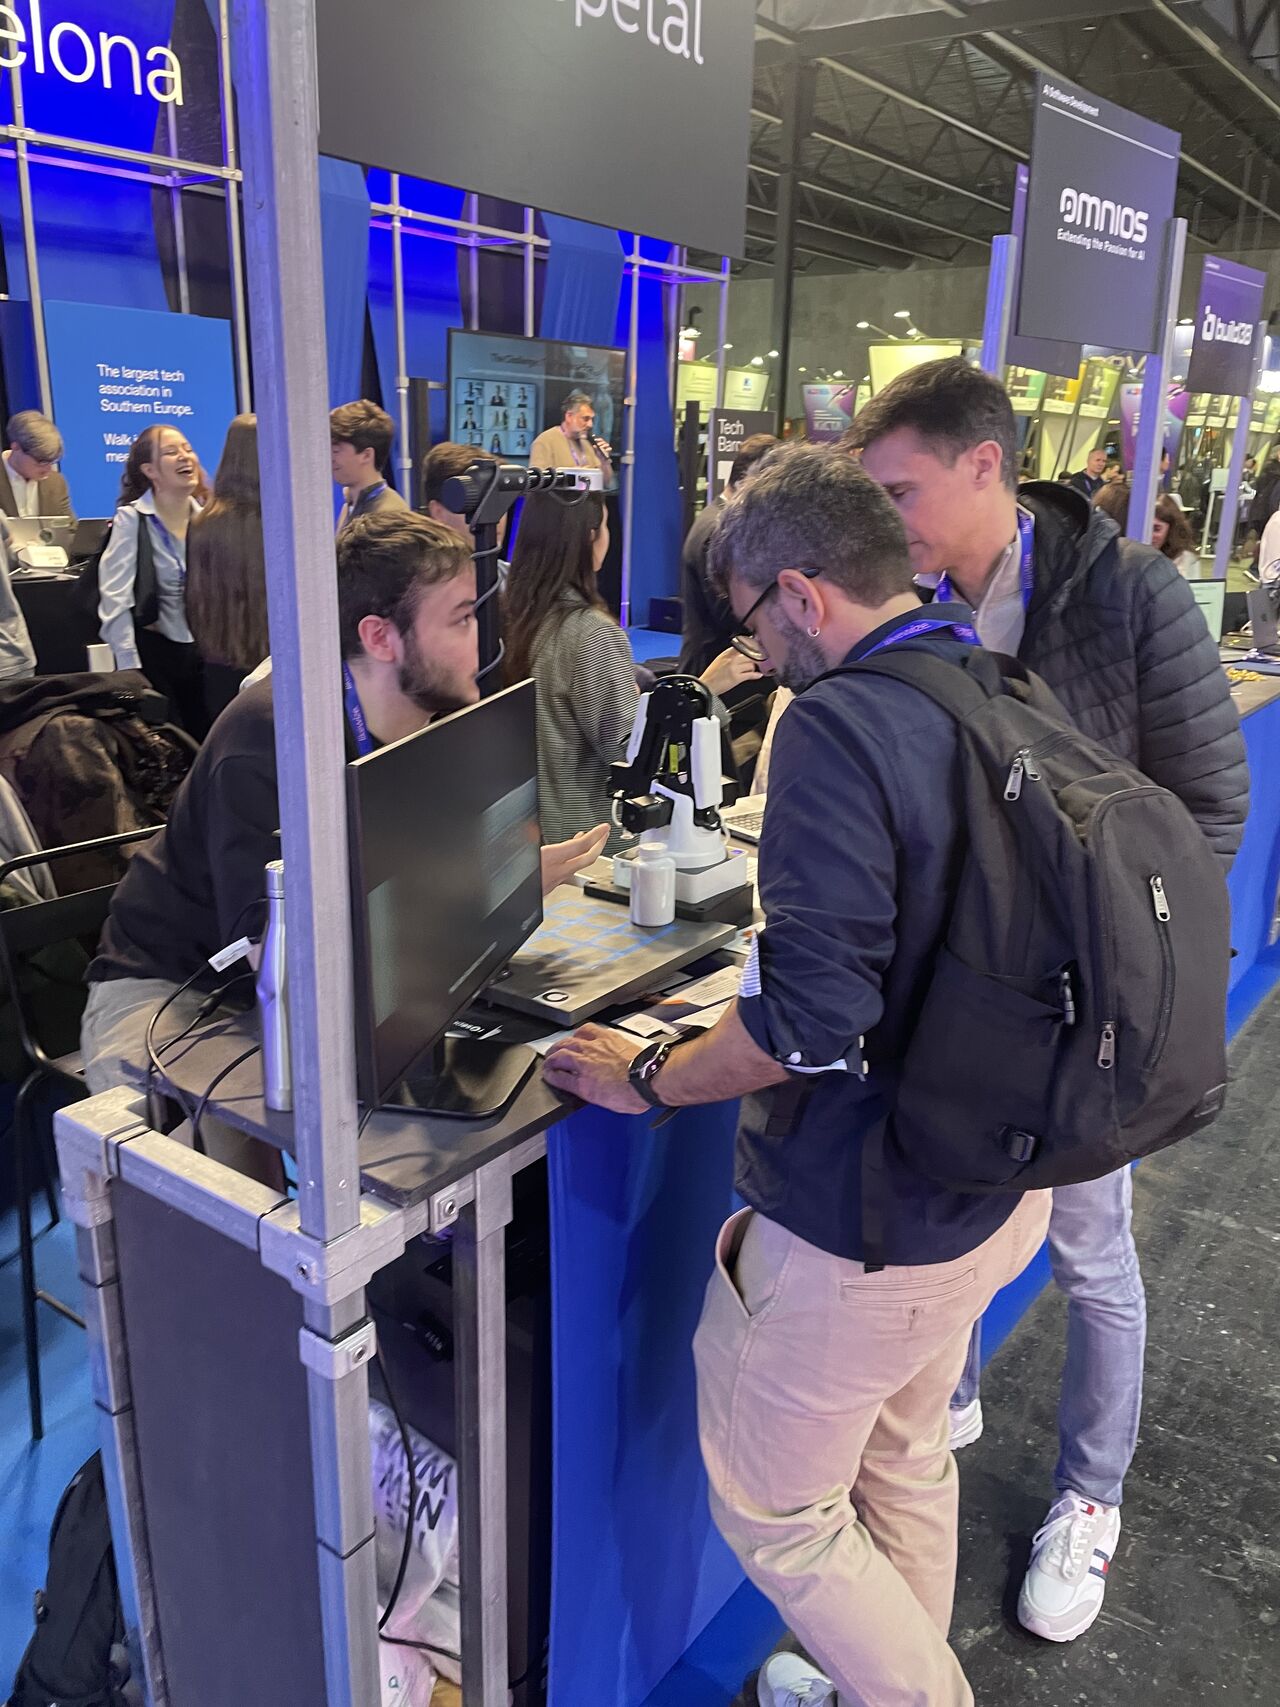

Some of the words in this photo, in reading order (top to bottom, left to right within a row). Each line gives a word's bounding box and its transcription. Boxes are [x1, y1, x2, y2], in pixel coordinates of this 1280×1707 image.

[96, 363, 120, 378] The
[121, 366, 160, 382] largest
[161, 369, 184, 382] tech
[98, 384, 160, 397] association
[161, 385, 172, 397] in
[100, 398, 152, 413] Southern
[153, 401, 194, 417] Europe.
[718, 418, 744, 435] Tech
[103, 432, 132, 446] Walk
